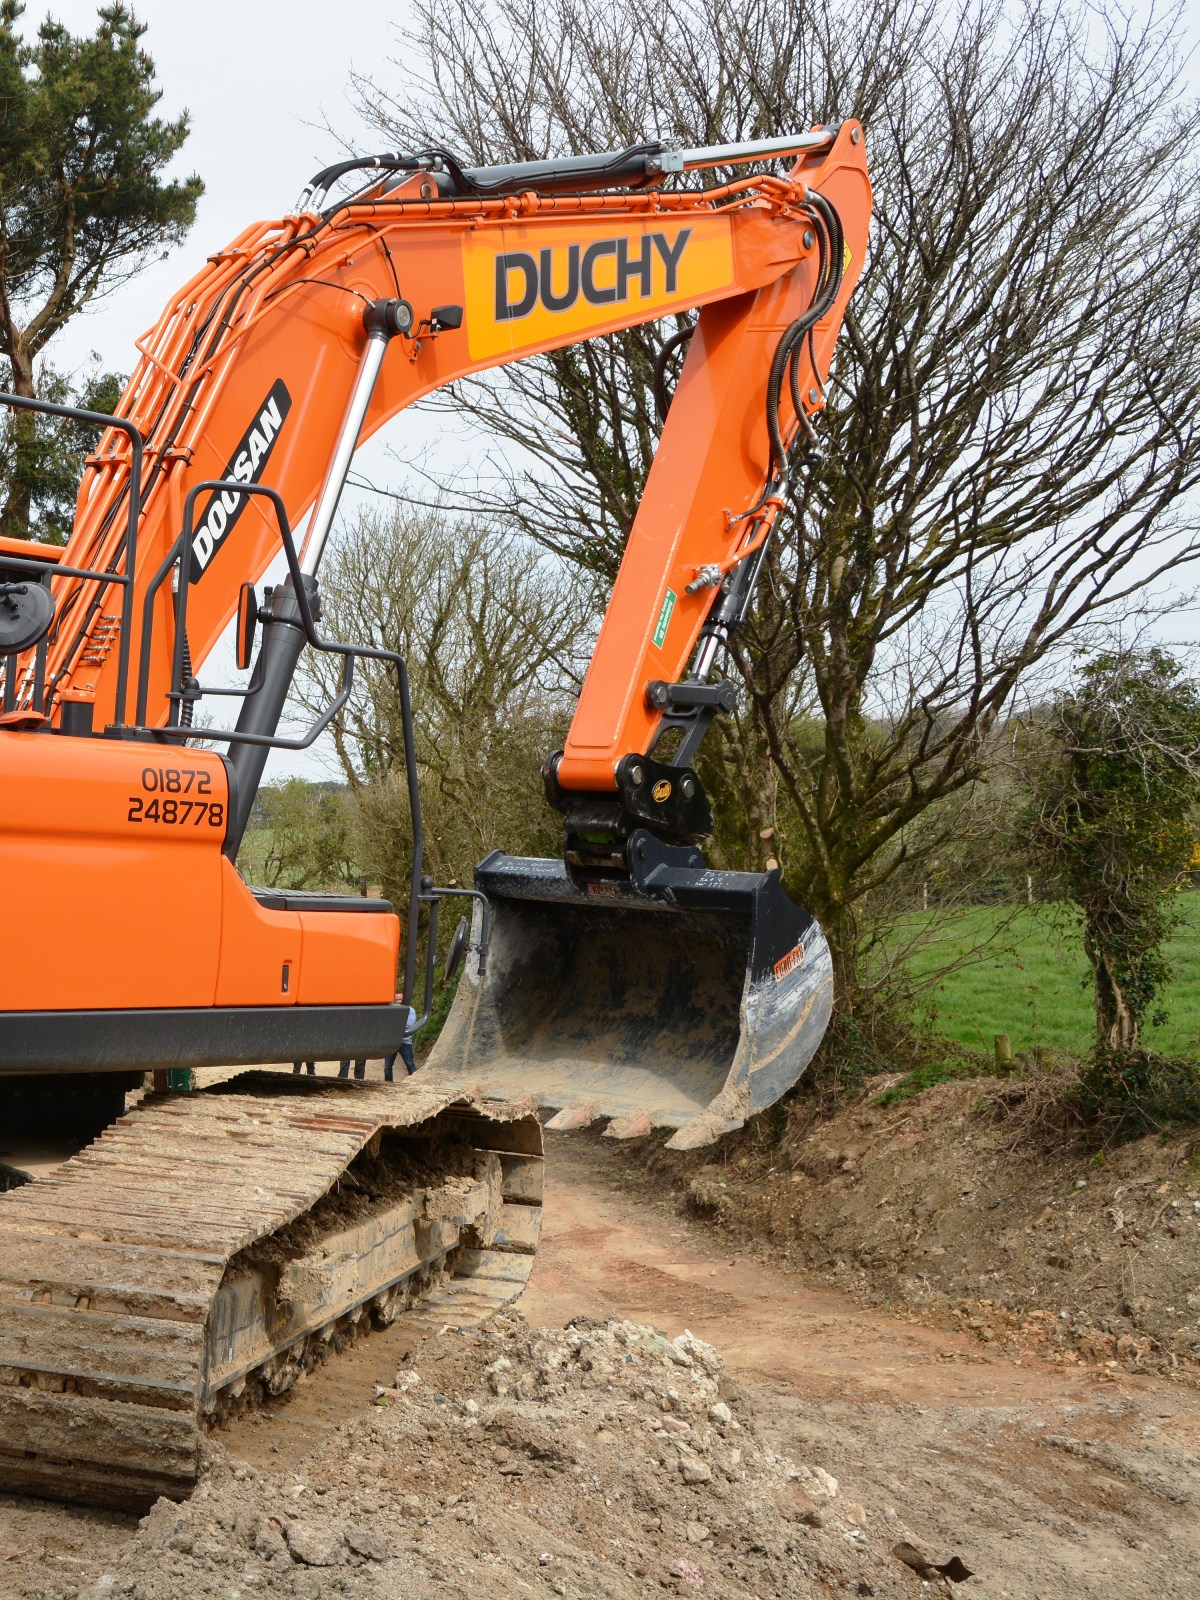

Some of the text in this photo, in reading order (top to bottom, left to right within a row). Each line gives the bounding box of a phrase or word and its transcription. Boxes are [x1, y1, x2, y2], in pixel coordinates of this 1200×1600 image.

[495, 227, 693, 323] DUCHY
[192, 396, 283, 570] DOOSAN
[127, 797, 224, 827] 248778
[141, 767, 211, 794] 01872
